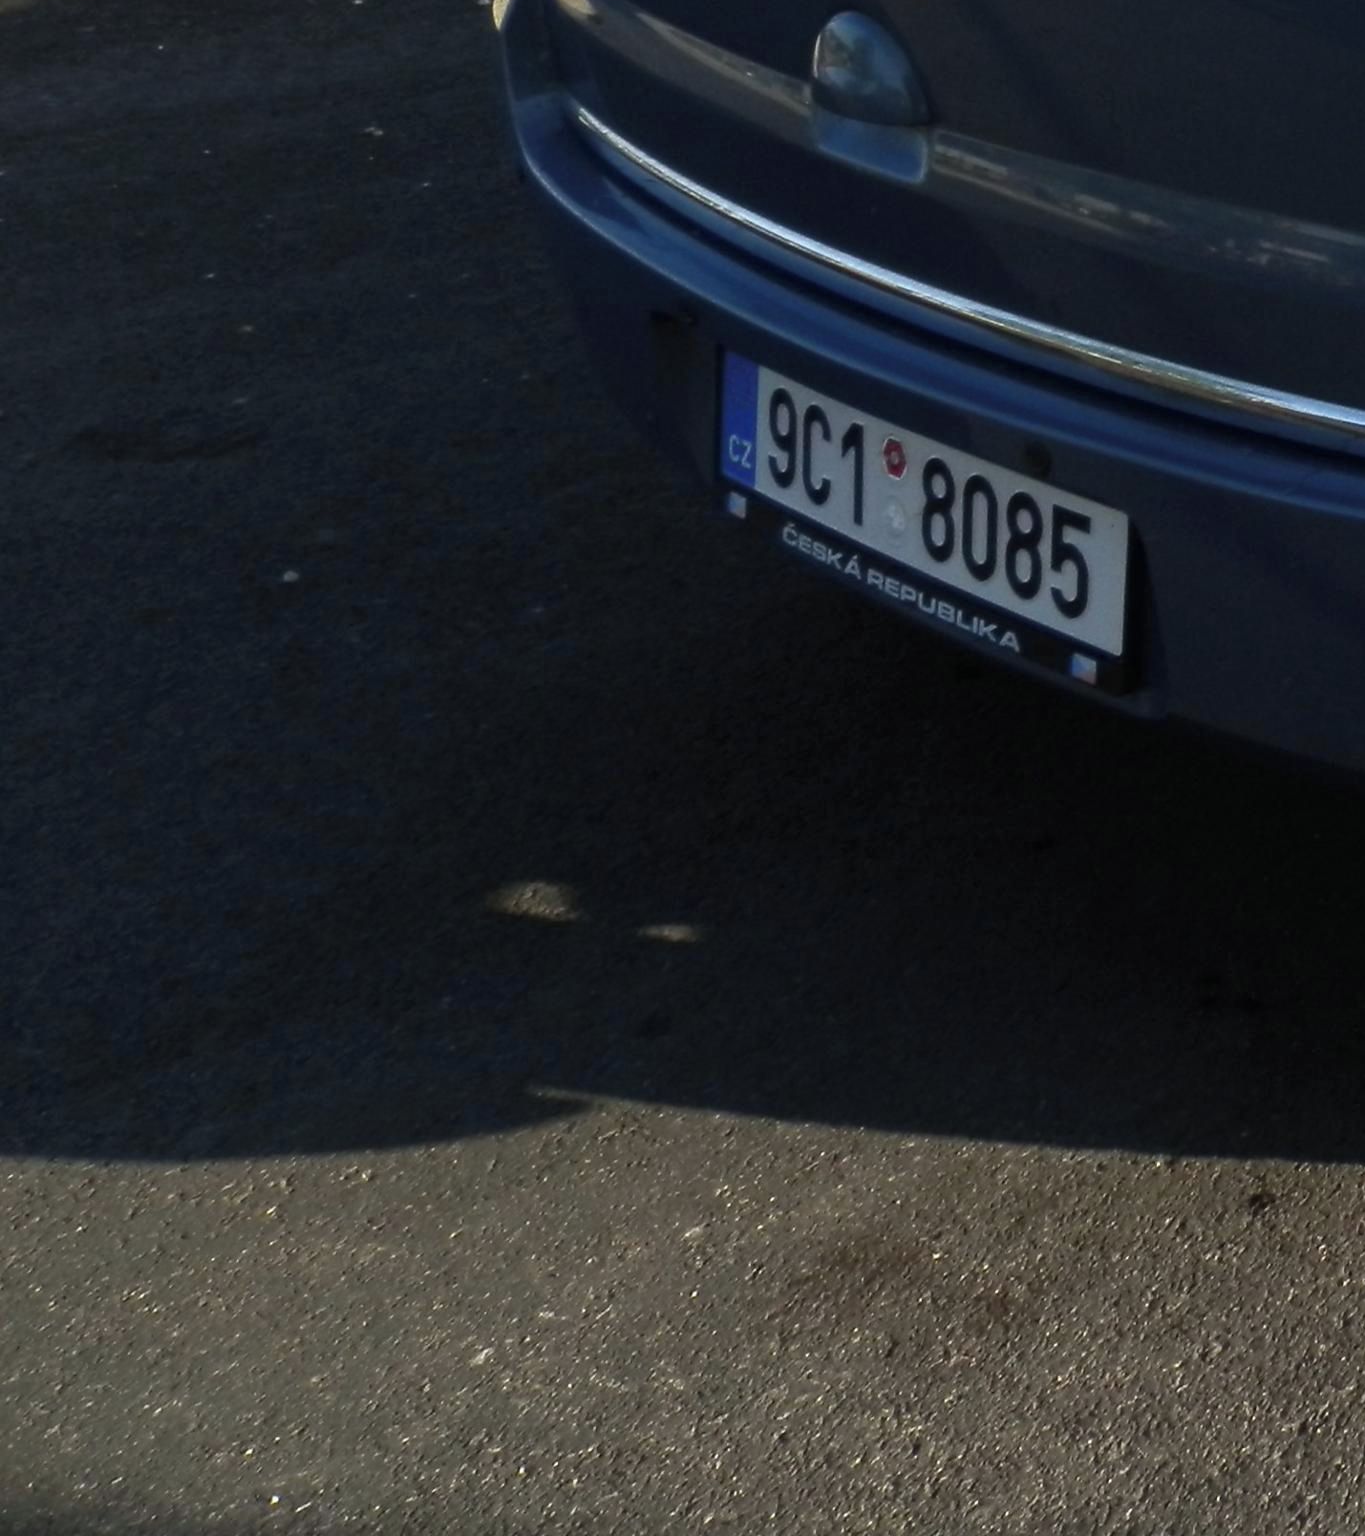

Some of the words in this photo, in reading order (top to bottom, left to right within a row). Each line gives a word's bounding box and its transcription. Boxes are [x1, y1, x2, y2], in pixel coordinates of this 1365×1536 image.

[728, 434, 752, 469] CZ
[767, 386, 865, 527] 9C1
[921, 457, 1092, 620] 8085
[781, 522, 862, 581] ČESKÁ
[866, 567, 1021, 654] REPUBLIKA
